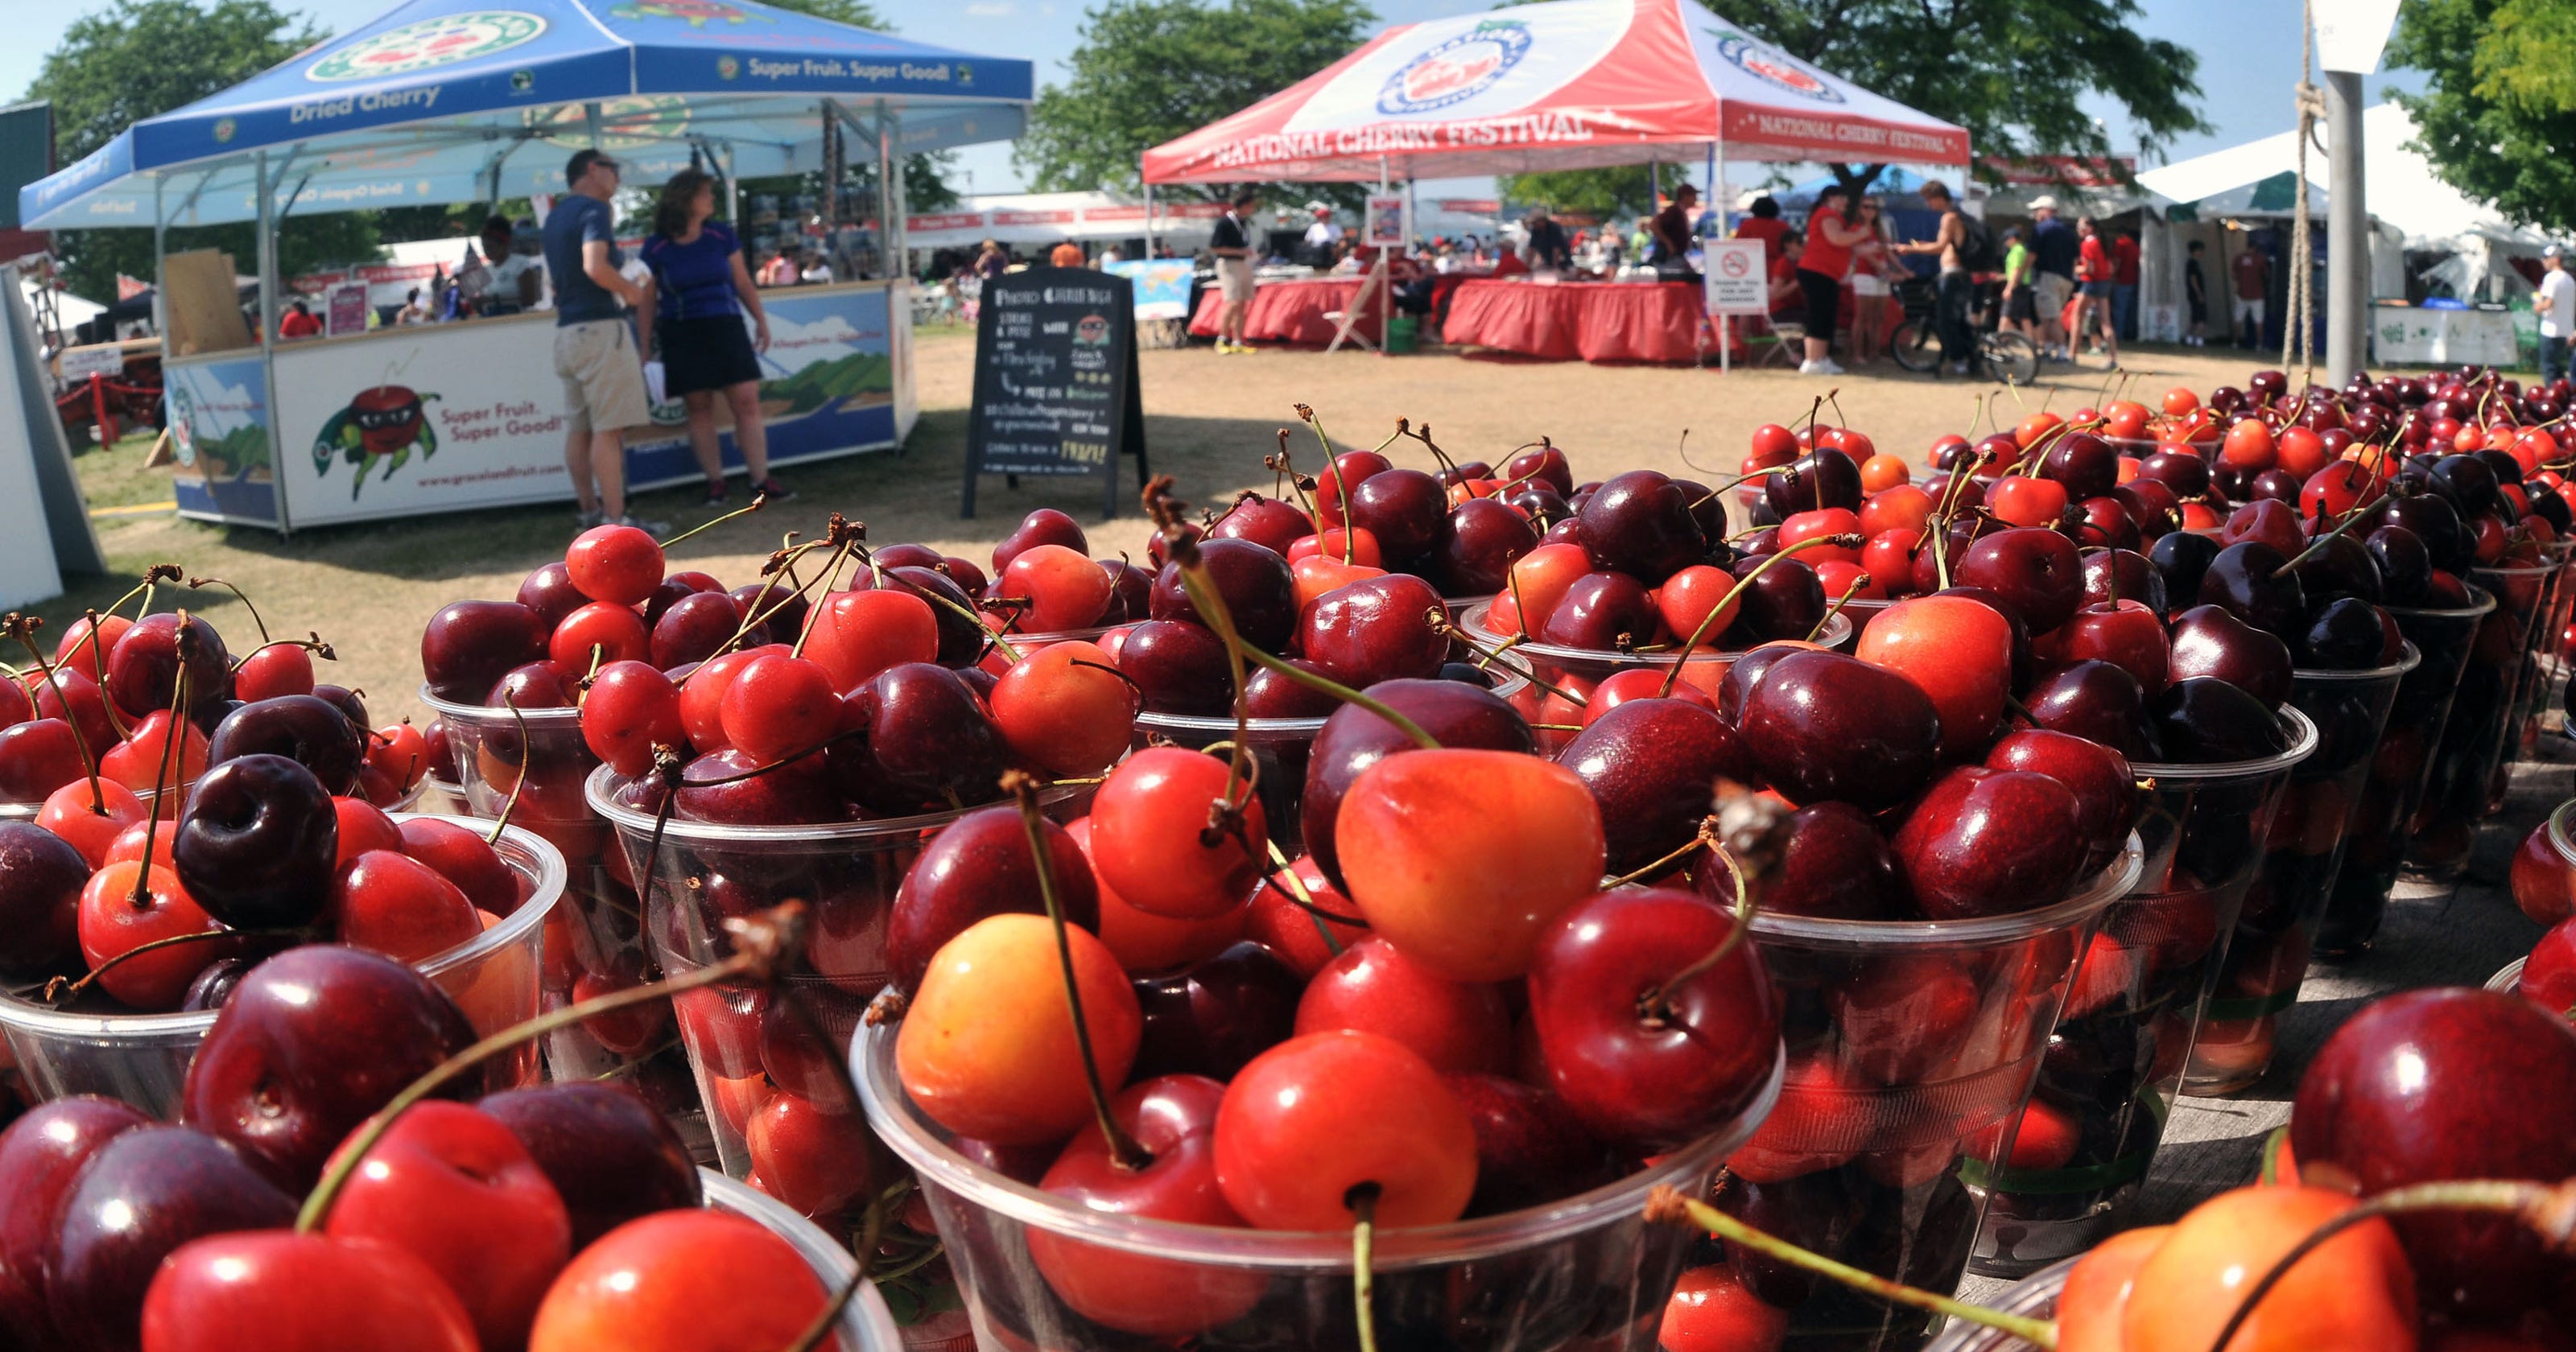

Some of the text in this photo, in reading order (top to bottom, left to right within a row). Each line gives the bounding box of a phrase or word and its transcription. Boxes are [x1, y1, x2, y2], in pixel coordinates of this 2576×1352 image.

[749, 58, 800, 80] Super
[803, 60, 847, 77] Fruit.
[850, 60, 897, 83] Super
[291, 85, 440, 123] Dried Cherry
[1212, 114, 1592, 168] NATIONAL CHERRY FESTIVAL
[1759, 114, 1946, 153] NATIONAL CHERRY FESTIVAL
[441, 401, 540, 425] Super Fruit.
[451, 414, 562, 443] Super Good!
